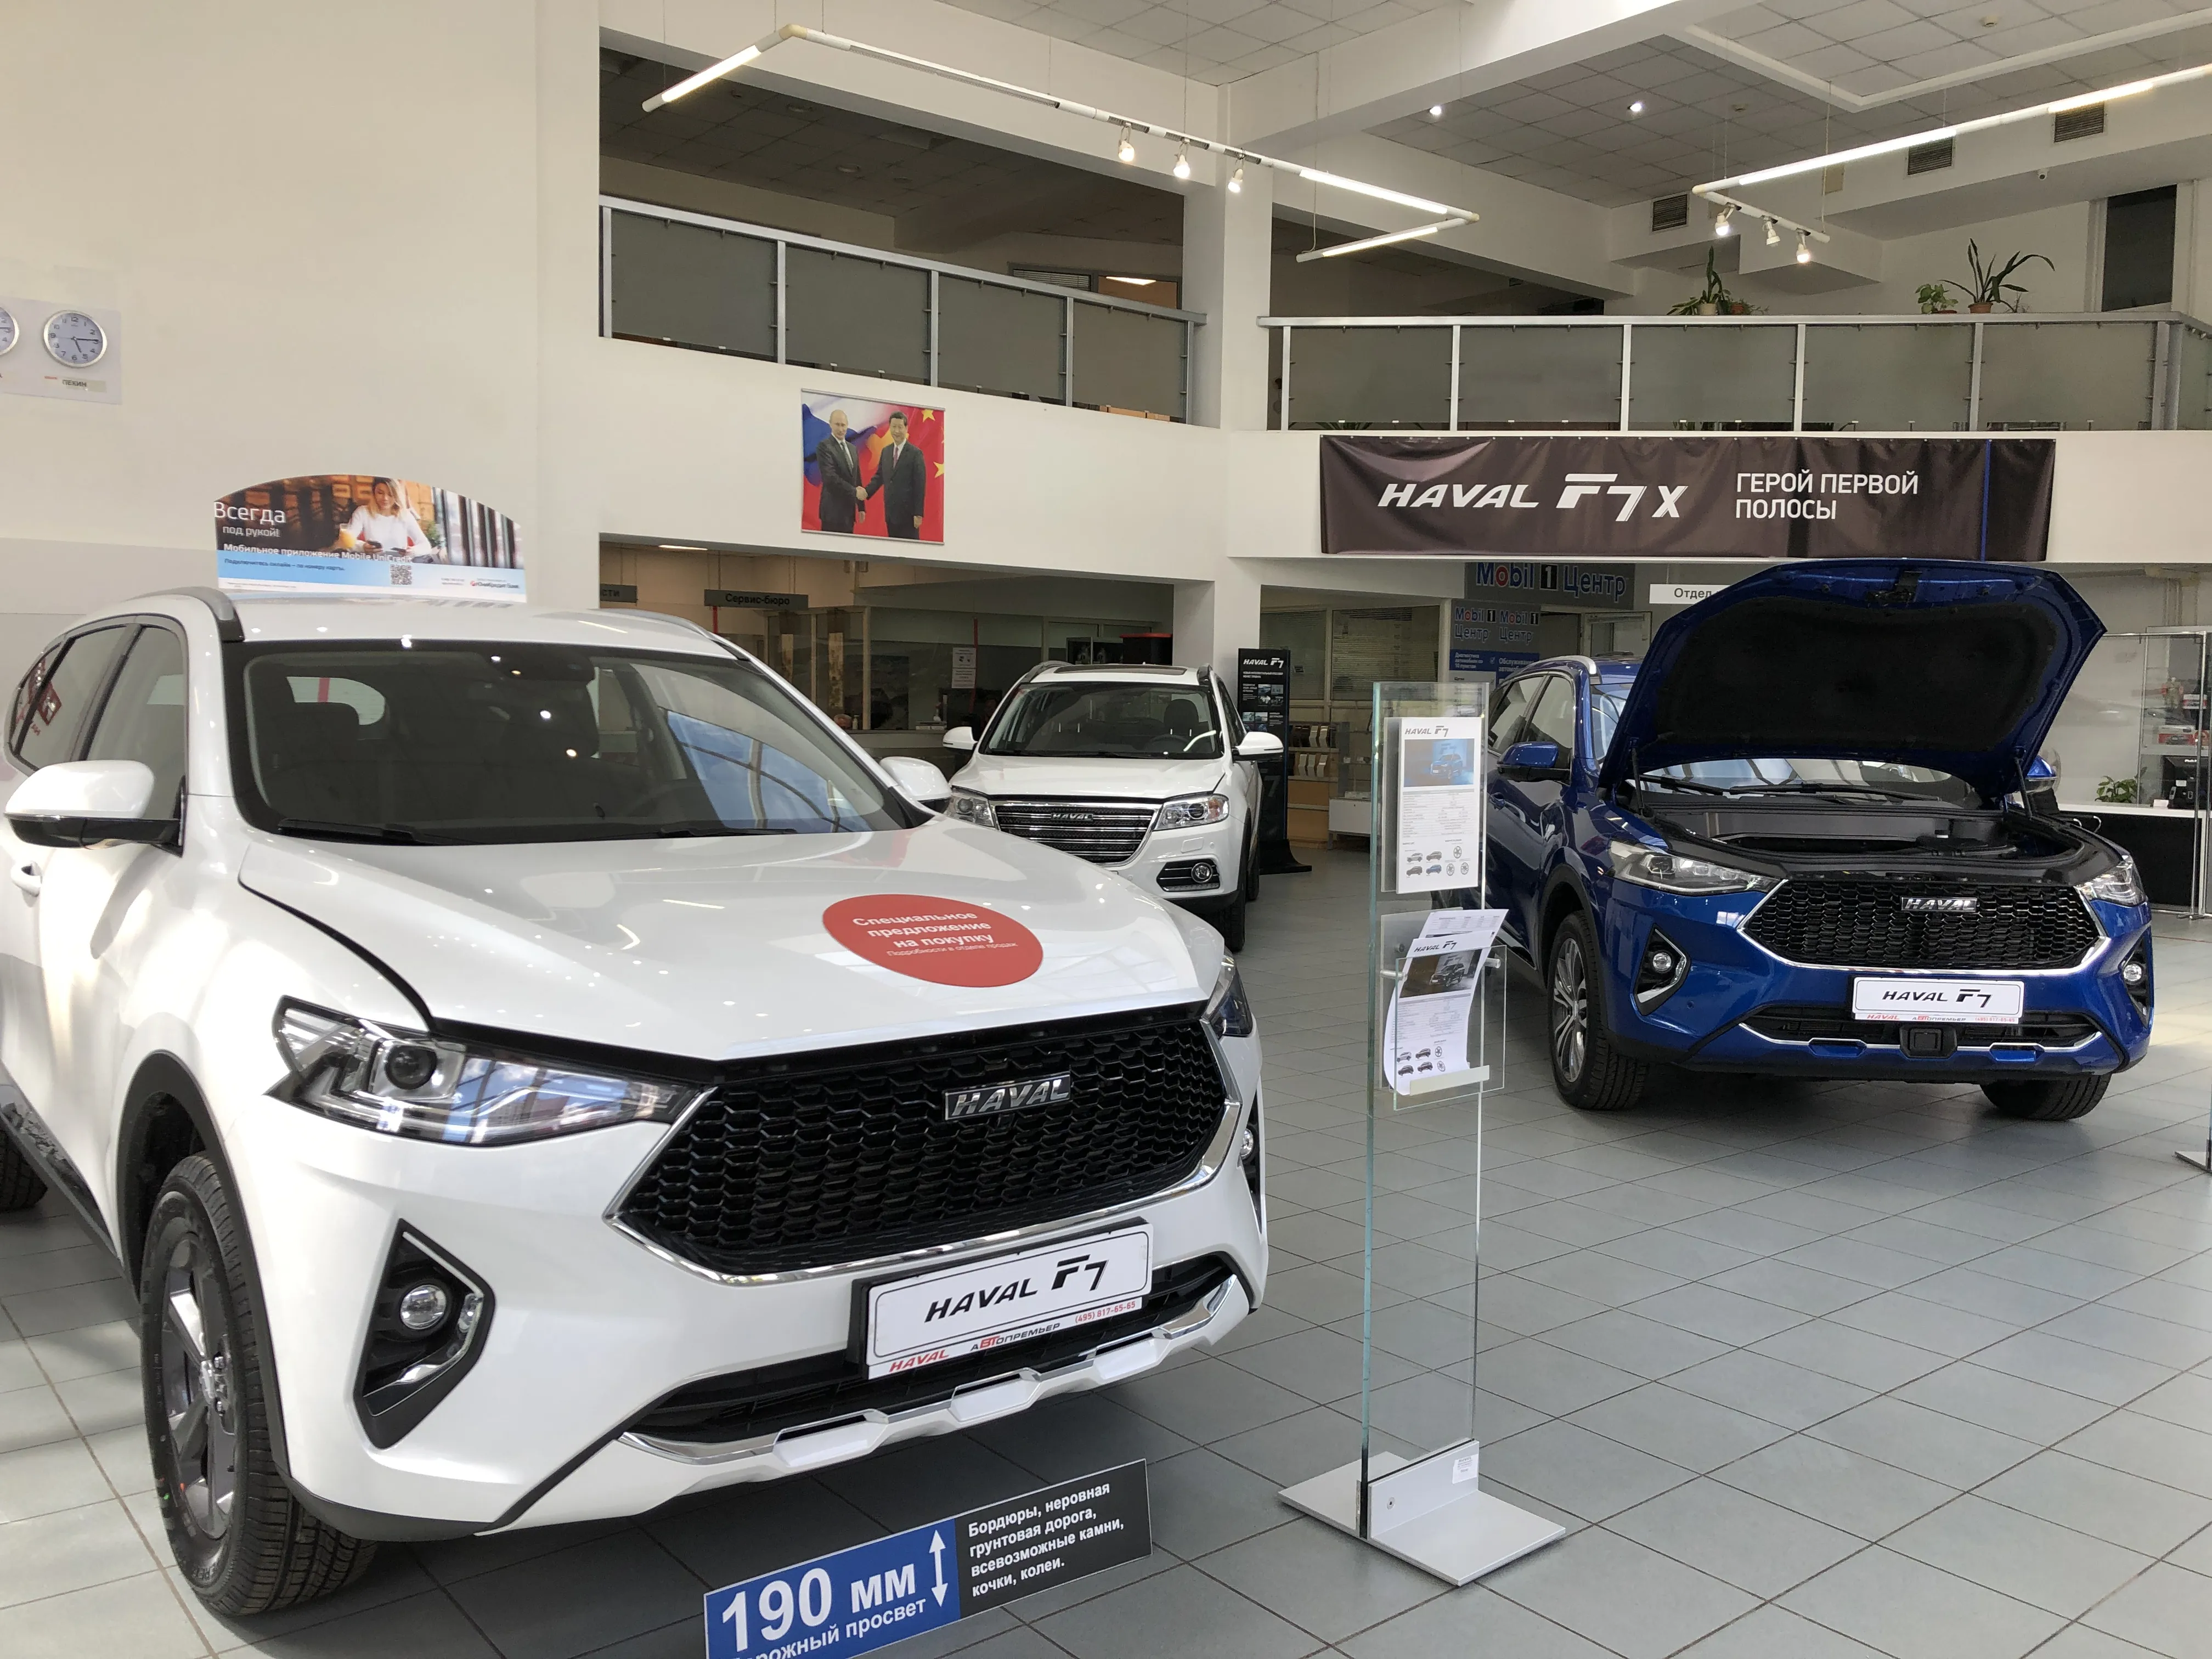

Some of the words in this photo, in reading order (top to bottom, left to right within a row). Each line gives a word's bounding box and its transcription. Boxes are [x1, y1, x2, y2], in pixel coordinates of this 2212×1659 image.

[62, 379, 87, 387] ПЕКИН
[1737, 469, 1813, 493] ГЕРОЙ
[1820, 470, 1918, 494] ПЕРВОЙ
[1378, 483, 1539, 509] HAVAL
[214, 501, 286, 525] Всегда
[1736, 499, 1837, 520] ПОЛОСЫ
[223, 526, 245, 537] под
[246, 528, 281, 538] рукой!
[223, 543, 280, 555] Мобильное
[281, 549, 340, 558] приложение
[1476, 562, 1534, 589] Mobil
[1542, 564, 1556, 589] 1
[1564, 565, 1627, 603] Центр
[601, 589, 620, 597] сти
[725, 592, 791, 606] Сервис-бюро
[1674, 588, 1712, 600] Отдел
[1455, 606, 1485, 622] Mobil
[1488, 610, 1495, 622] 1
[1499, 610, 1528, 625] Mobil
[1532, 613, 1538, 624] 1
[1455, 624, 1489, 643] Центр
[1499, 627, 1533, 644] Центр
[1270, 658, 1284, 668] F7
[1435, 725, 1449, 737] F7
[1904, 898, 1975, 911] HAVAL
[853, 912, 978, 927] Специальное
[867, 921, 992, 938] предложение
[893, 939, 919, 948] на
[920, 934, 995, 946] покупку
[1414, 944, 1440, 952] HAVAL
[1442, 940, 1458, 950] F7
[1882, 991, 1948, 1002] HAVAL
[1956, 989, 1994, 1008] F7
[951, 1079, 1069, 1116] HAVAL
[924, 1278, 1037, 1323] HAVAL
[1051, 1254, 1109, 1291] F7
[889, 1350, 950, 1373] HAVAL
[1075, 1311, 1096, 1323] (495)
[1097, 1301, 1136, 1317] 817-65-65
[968, 1506, 1042, 1537] Бордюры,
[1045, 1483, 1110, 1513] неровная
[969, 1525, 1041, 1558] грунтовая
[1045, 1508, 1097, 1534] дорога,
[971, 1533, 1076, 1577] всевозможные
[1079, 1519, 1124, 1541] камни,
[972, 1574, 1017, 1597] кочки,
[1020, 1557, 1065, 1580] колеи.
[722, 1567, 832, 1652] 190
[850, 1563, 916, 1613] мм
[733, 1623, 840, 1659] ожный
[845, 1598, 926, 1639] просвет
